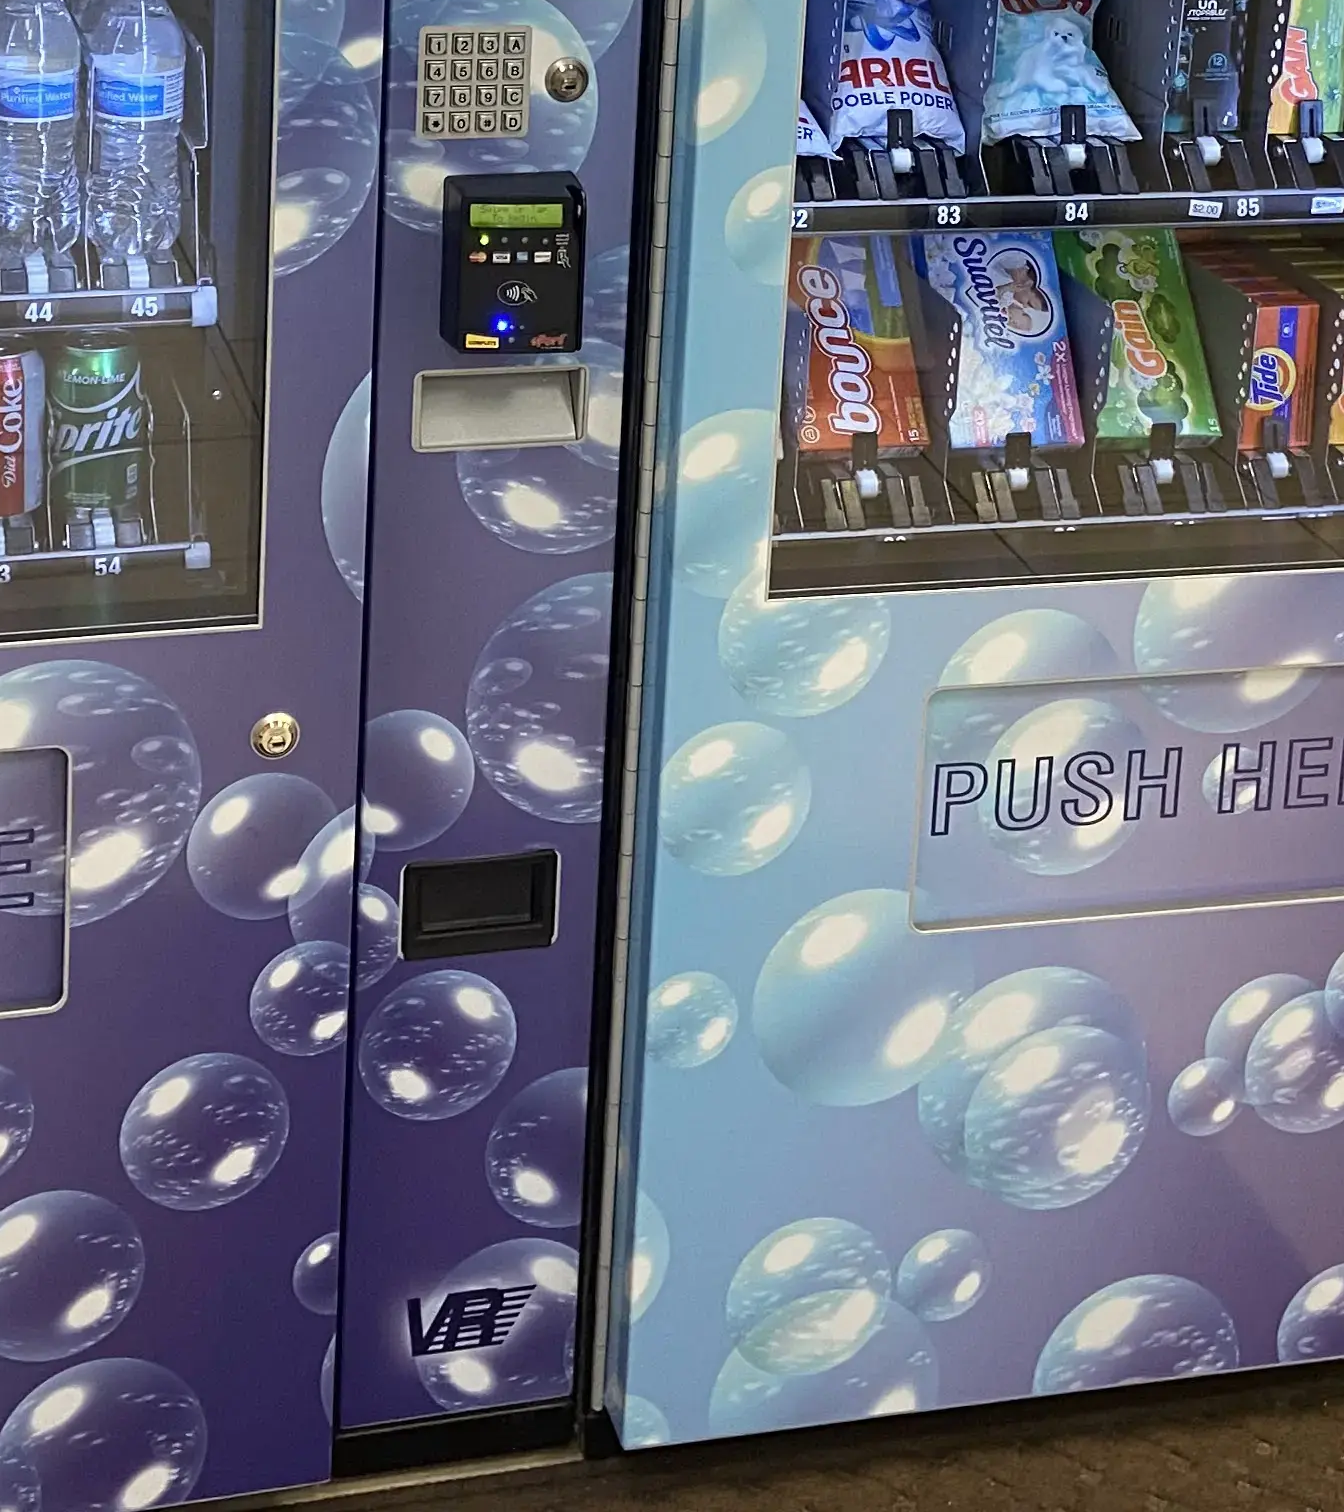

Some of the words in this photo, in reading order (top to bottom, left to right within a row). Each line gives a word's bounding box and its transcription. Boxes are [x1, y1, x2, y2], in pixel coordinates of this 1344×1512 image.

[838, 57, 951, 92] ARIEL
[832, 91, 896, 110] DOBLE
[900, 91, 954, 111] PODER
[937, 205, 962, 225] 83
[1064, 202, 1089, 221] 84
[1236, 198, 1260, 217] 85
[954, 237, 1015, 350] Suavitel
[24, 302, 53, 323] 44
[130, 296, 158, 317] 45
[1112, 299, 1168, 379] Gain
[797, 264, 883, 436] bounce
[62, 372, 126, 385] LEMON-LIME
[1247, 353, 1279, 408] Tide
[94, 556, 121, 576] 54
[929, 744, 1184, 838] PUSH
